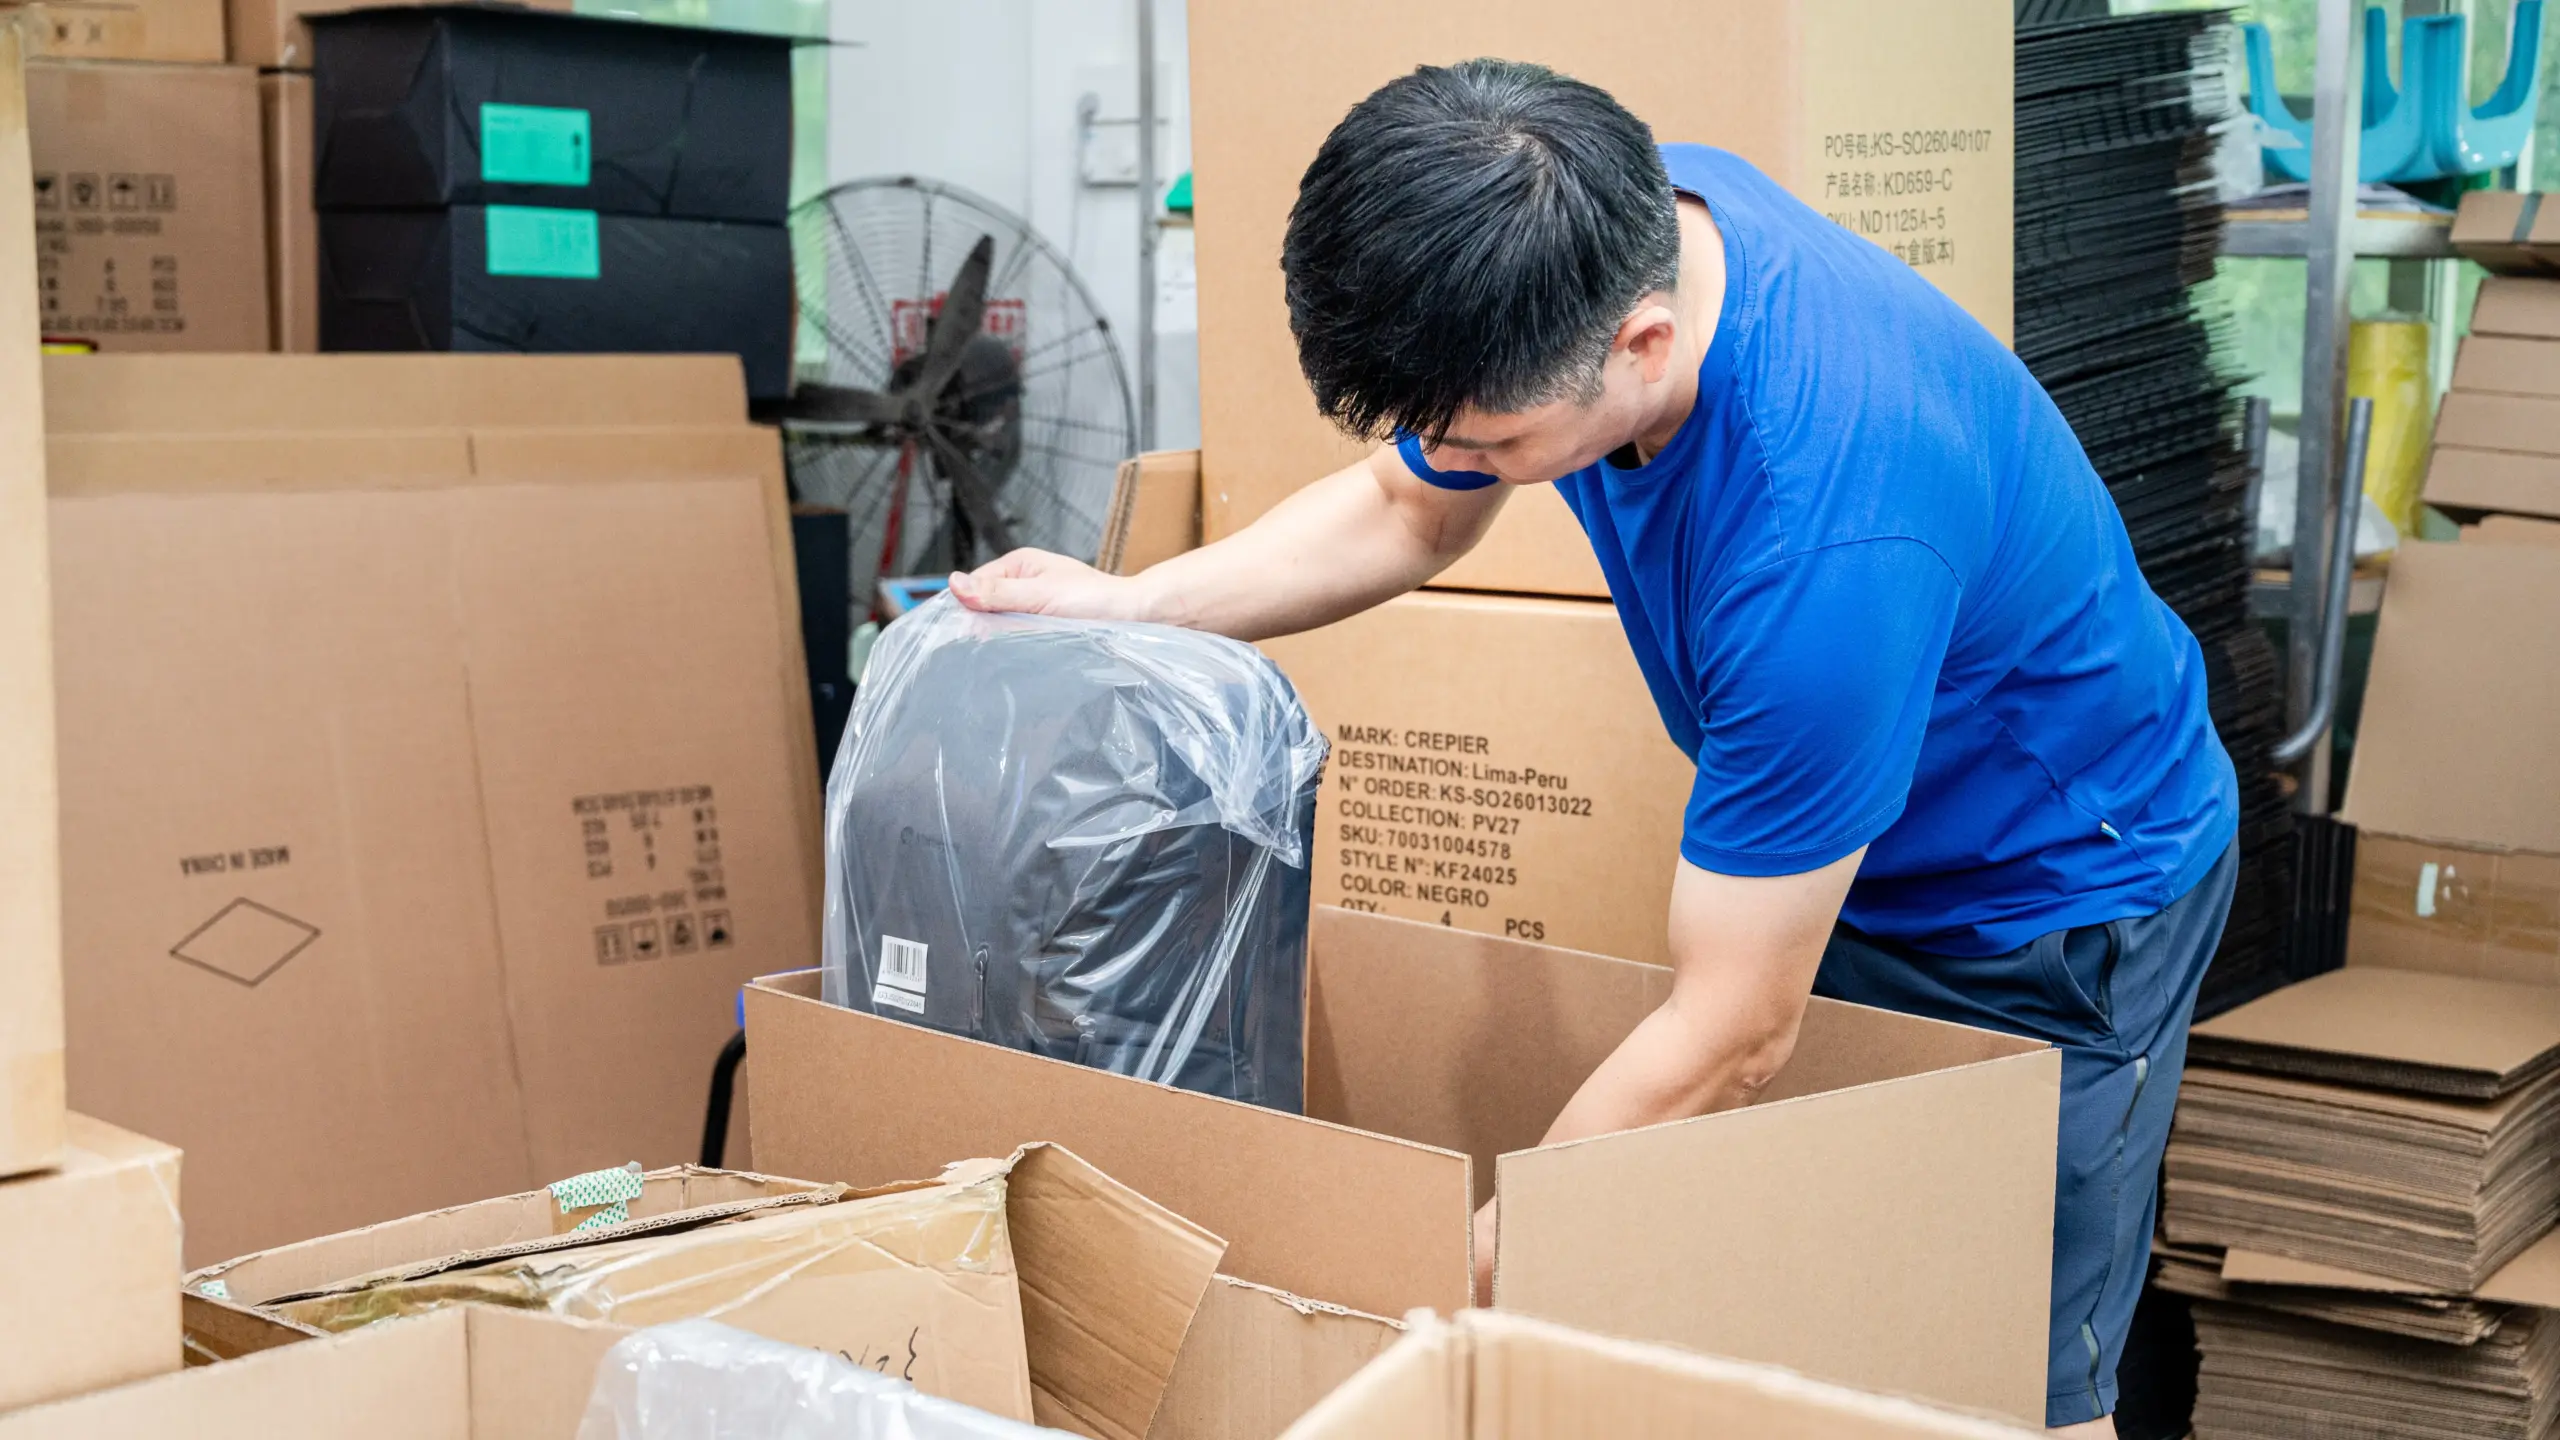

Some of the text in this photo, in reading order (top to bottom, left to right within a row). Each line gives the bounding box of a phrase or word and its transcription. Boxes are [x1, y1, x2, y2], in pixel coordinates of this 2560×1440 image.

[1860, 206, 1946, 234] ND1125A-5
[1338, 724, 1490, 755] MARK: CREPIER
[1338, 749, 1568, 791] DESTINATION: Lima-Peru
[1364, 777, 1438, 801] ORDER:
[1440, 784, 1593, 817] KS-SO26013022
[1339, 800, 1521, 836] COLLECTION: PV27
[1339, 824, 1512, 860] SKU: 70031004578
[179, 845, 290, 878] MADE IN CHINA
[1340, 848, 1398, 873] STYLE
[1434, 861, 1518, 887] KF24025
[1340, 872, 1490, 909] COLOR: NEGRO
[1440, 909, 1452, 927] 4
[1504, 917, 1546, 941] PCS
